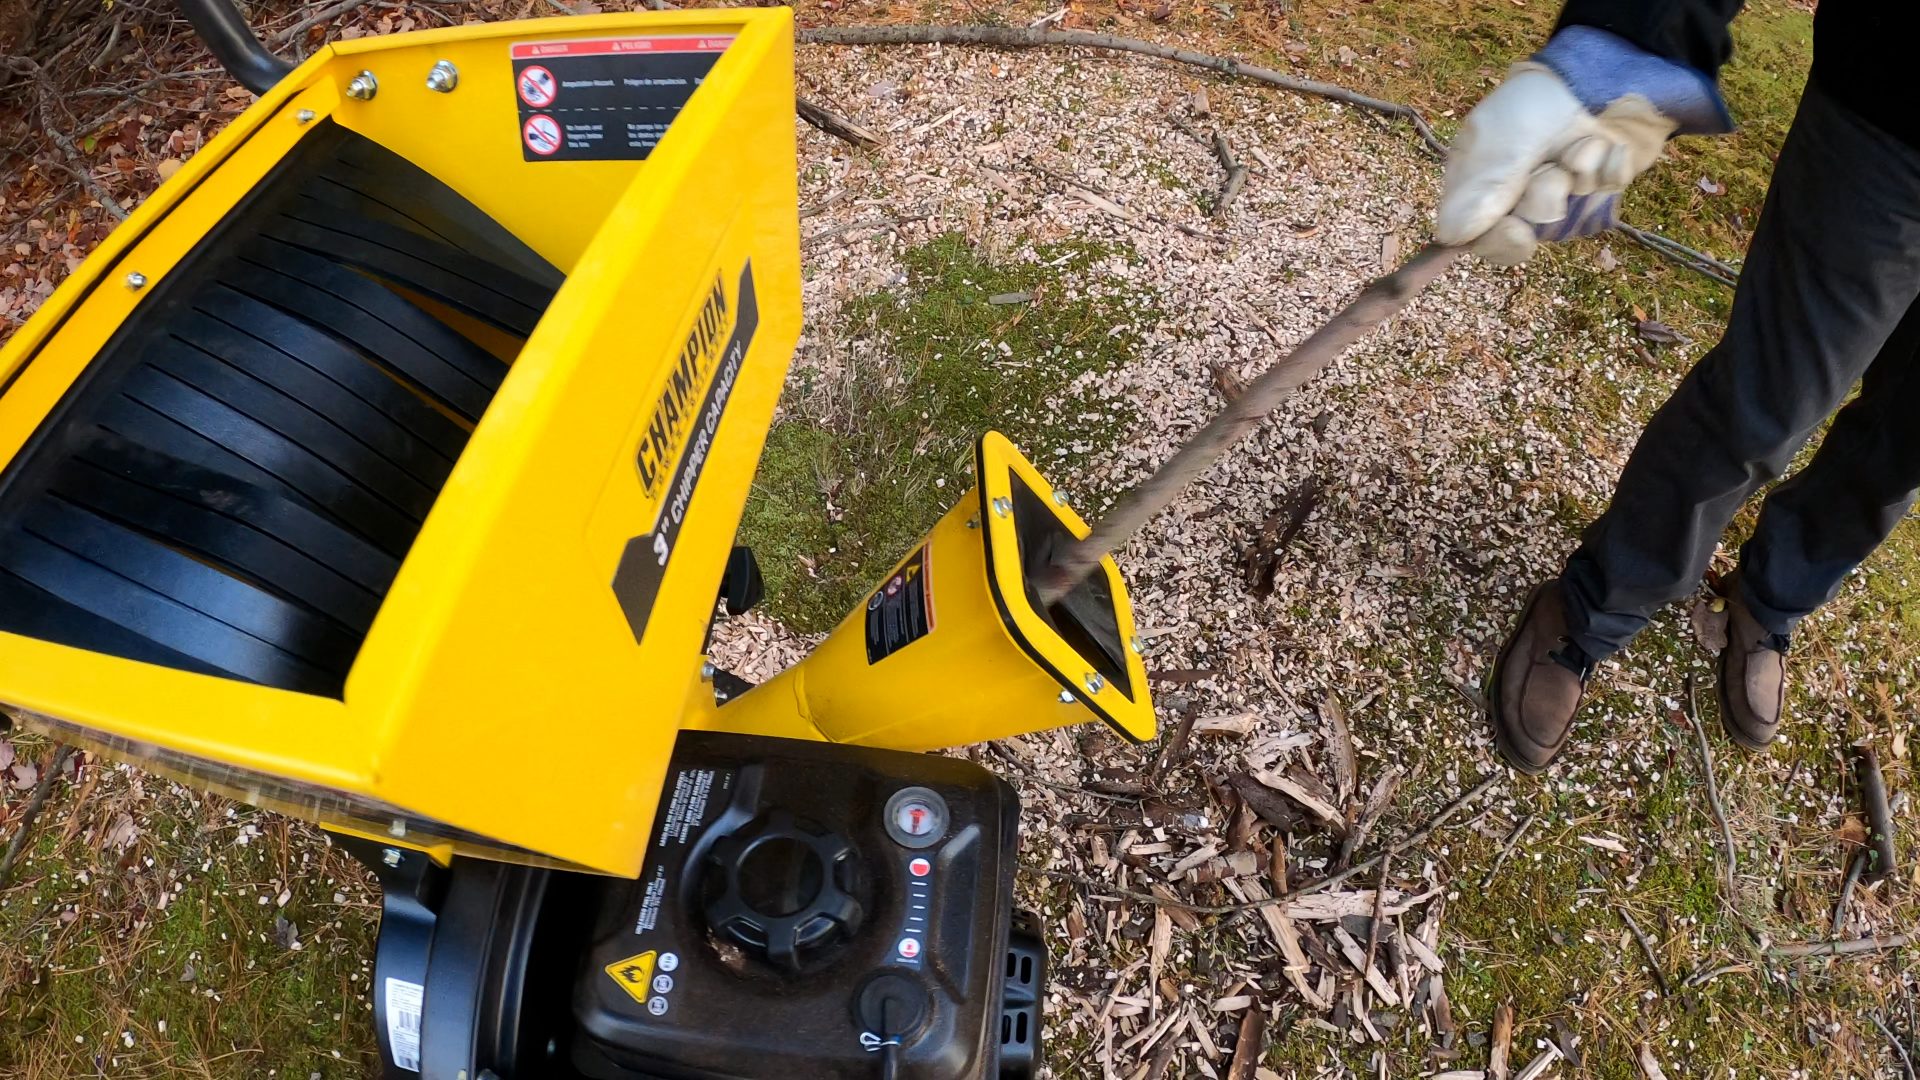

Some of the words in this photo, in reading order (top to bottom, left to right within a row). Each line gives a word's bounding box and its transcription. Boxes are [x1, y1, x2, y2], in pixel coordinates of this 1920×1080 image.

[636, 277, 728, 493] CHAMPION
[654, 518, 669, 566] 3"
[671, 431, 708, 526] CHIPPER
[705, 339, 743, 434] CAPACITY
